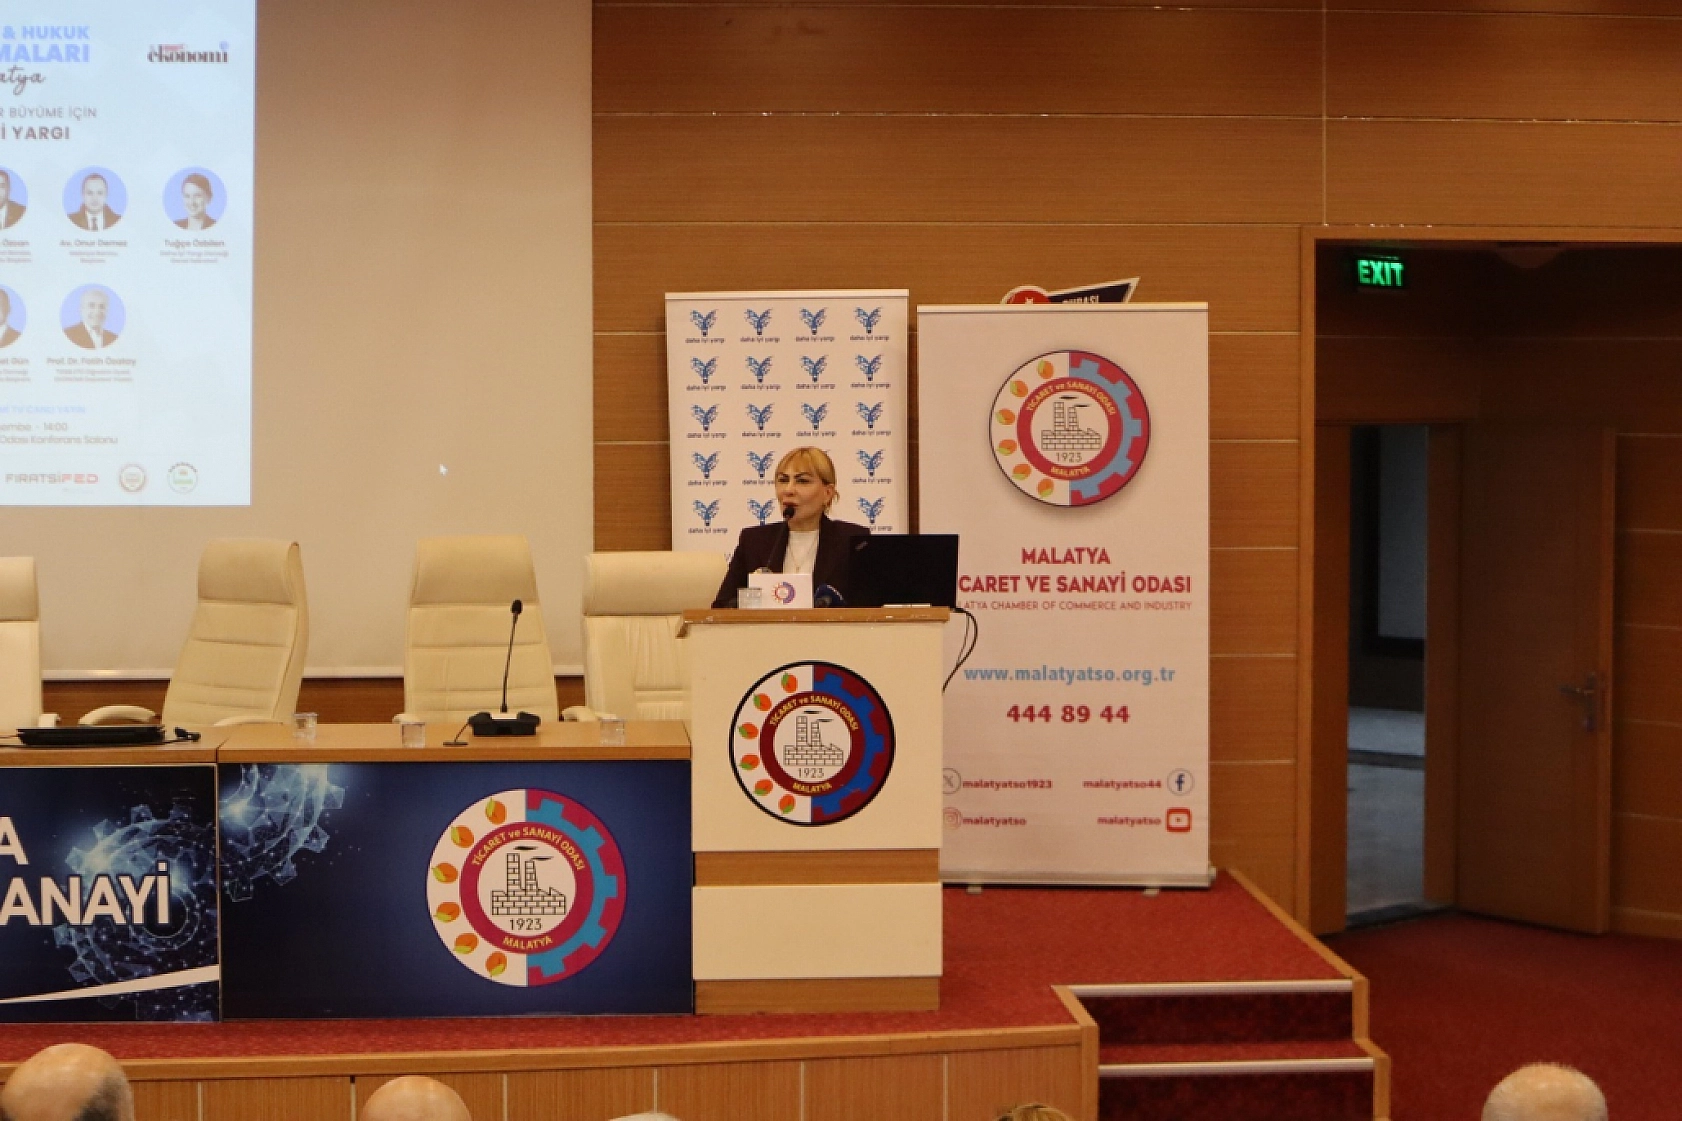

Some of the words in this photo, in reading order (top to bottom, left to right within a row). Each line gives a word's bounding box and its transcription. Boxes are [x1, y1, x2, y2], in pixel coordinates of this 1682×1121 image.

[3, 26, 16, 39] &
[22, 26, 90, 39] HUKUK
[10, 105, 63, 118] BÜYÜME
[68, 105, 97, 121] İÇİN
[12, 126, 70, 140] YARGI
[1358, 260, 1404, 286] EXIT
[1096, 391, 1116, 416] ODASI
[1055, 452, 1082, 462] 1923
[1051, 466, 1090, 476] MALATYA
[1021, 547, 1111, 565] MALATYA
[959, 575, 1020, 593] CARET
[1026, 575, 1050, 593] VE
[1057, 571, 1126, 593] SANAYİ
[1132, 575, 1191, 593] ODASI
[991, 601, 1038, 610] CHAMBER
[1042, 601, 1055, 610] OF
[1059, 601, 1116, 610] COMMERCE
[1120, 601, 1141, 610] AND
[1144, 601, 1192, 610] INDUSTRY
[964, 665, 1176, 686] www.malatyatso.org.tr
[840, 705, 859, 731] ODASI
[1007, 704, 1051, 723] 444
[1061, 704, 1091, 723] 89
[1099, 704, 1130, 723] 44
[798, 768, 824, 778] 1923
[792, 782, 832, 793] MALATYA
[963, 779, 1052, 790] malatyatso1923
[1083, 779, 1162, 790] malatyatso44
[963, 816, 1027, 827] malatyatso
[1097, 816, 1161, 827] malatyatso
[561, 841, 585, 871] ODASI
[0, 861, 169, 925] ANAYİ
[509, 918, 542, 930] 1923
[503, 936, 553, 949] MALATYA
